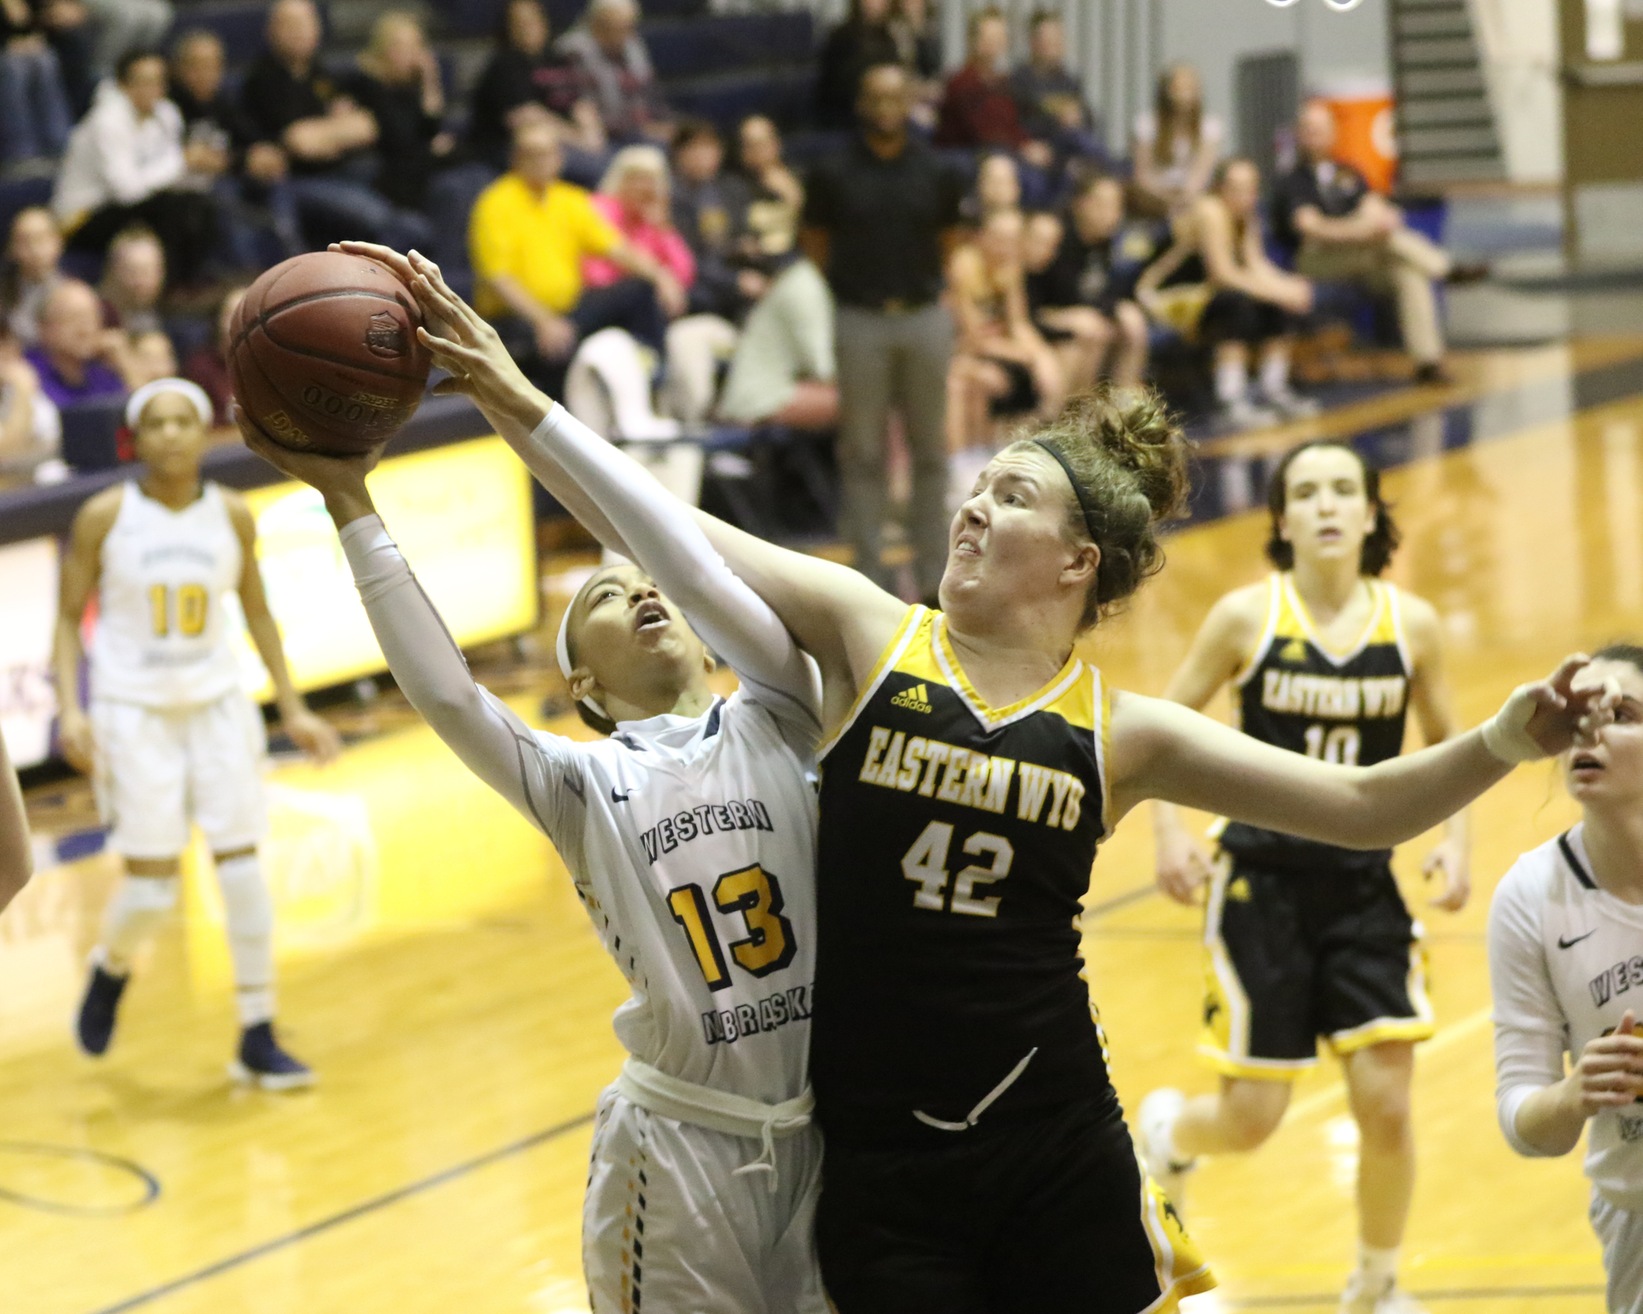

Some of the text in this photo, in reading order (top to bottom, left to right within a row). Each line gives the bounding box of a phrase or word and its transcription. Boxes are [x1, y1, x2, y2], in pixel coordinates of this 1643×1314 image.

[150, 581, 208, 637] 10
[890, 694, 933, 714] adidas
[1262, 668, 1360, 721] EASTERN
[858, 725, 1017, 815] EASTERN
[639, 798, 775, 866] WESTERN
[901, 819, 1015, 918] 42
[666, 862, 798, 993] 13
